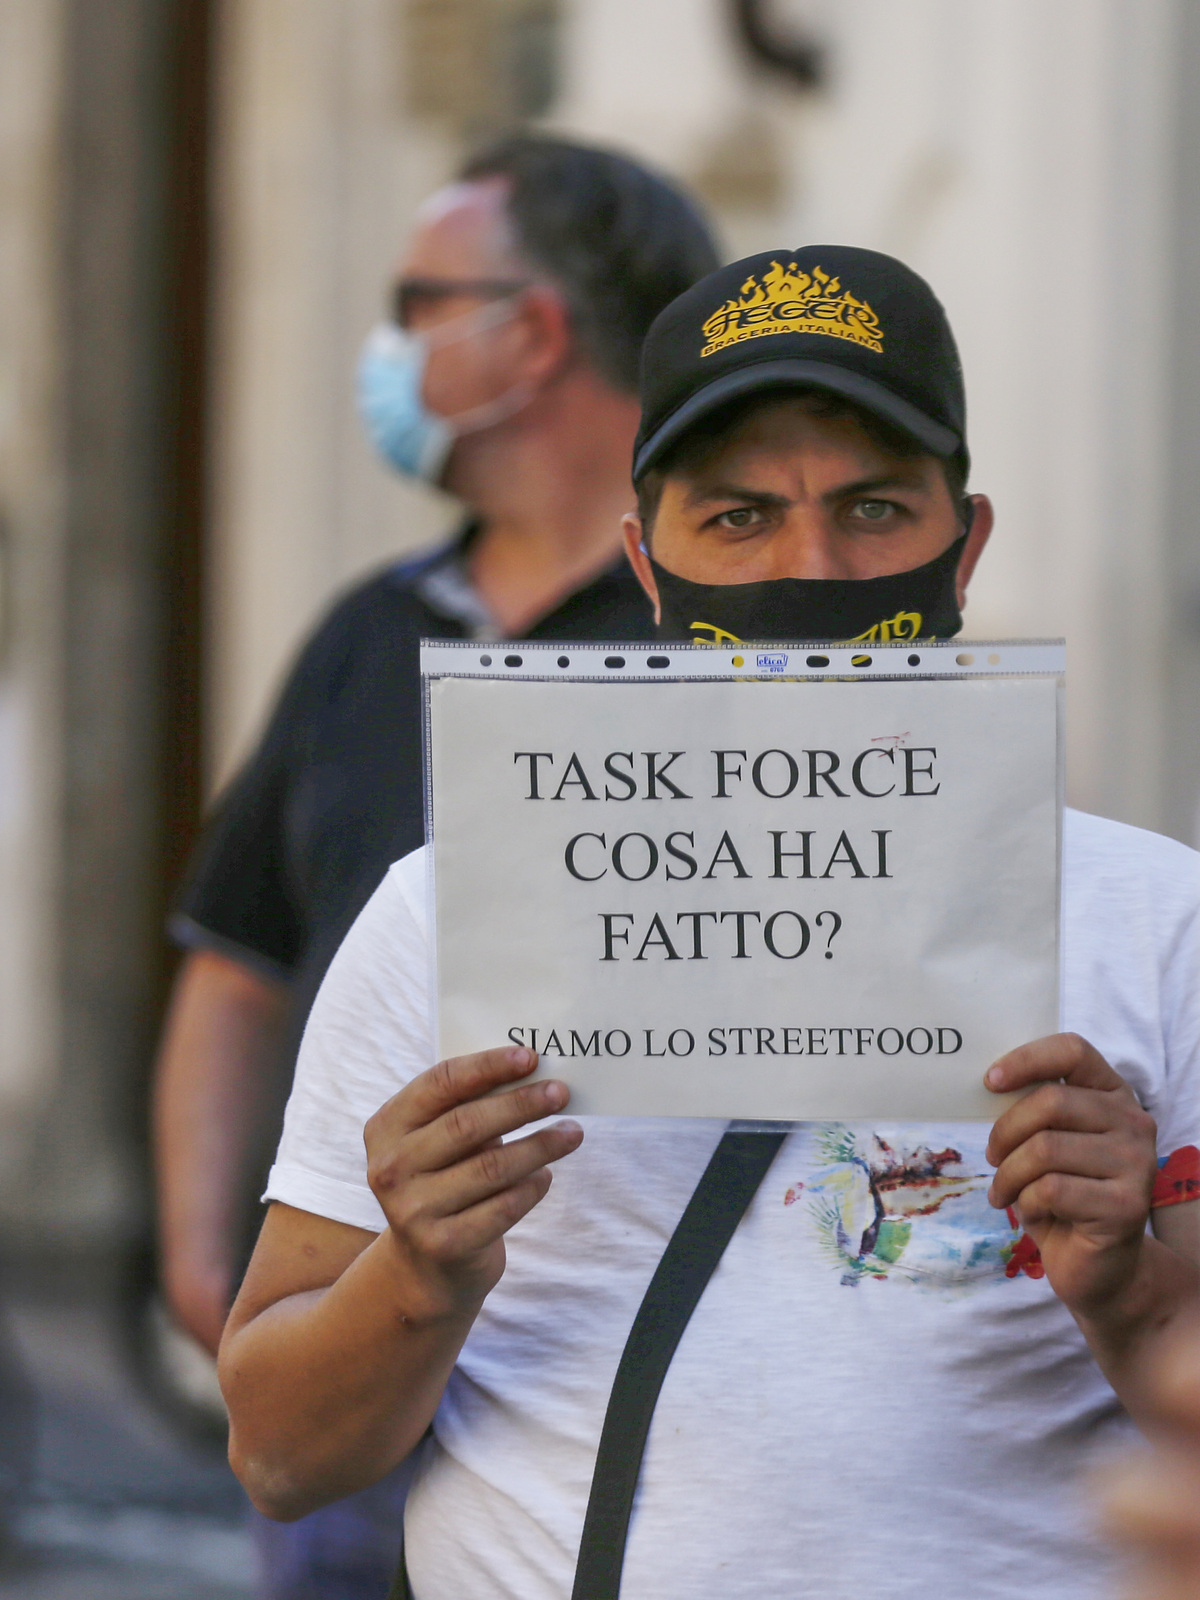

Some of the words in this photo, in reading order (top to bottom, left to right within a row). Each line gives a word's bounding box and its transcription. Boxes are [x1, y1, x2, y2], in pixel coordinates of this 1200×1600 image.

[703, 324, 791, 355] BRACERIA
[799, 324, 883, 350] ITALIANA
[514, 752, 693, 801] TASK
[711, 747, 941, 798] FORCE
[564, 831, 752, 881] COSA
[767, 830, 894, 879] HAI
[598, 911, 842, 961] FATTO?
[507, 1026, 632, 1057] SIAMO
[643, 1029, 695, 1057] LO
[708, 1027, 963, 1056] STREETFOOD
